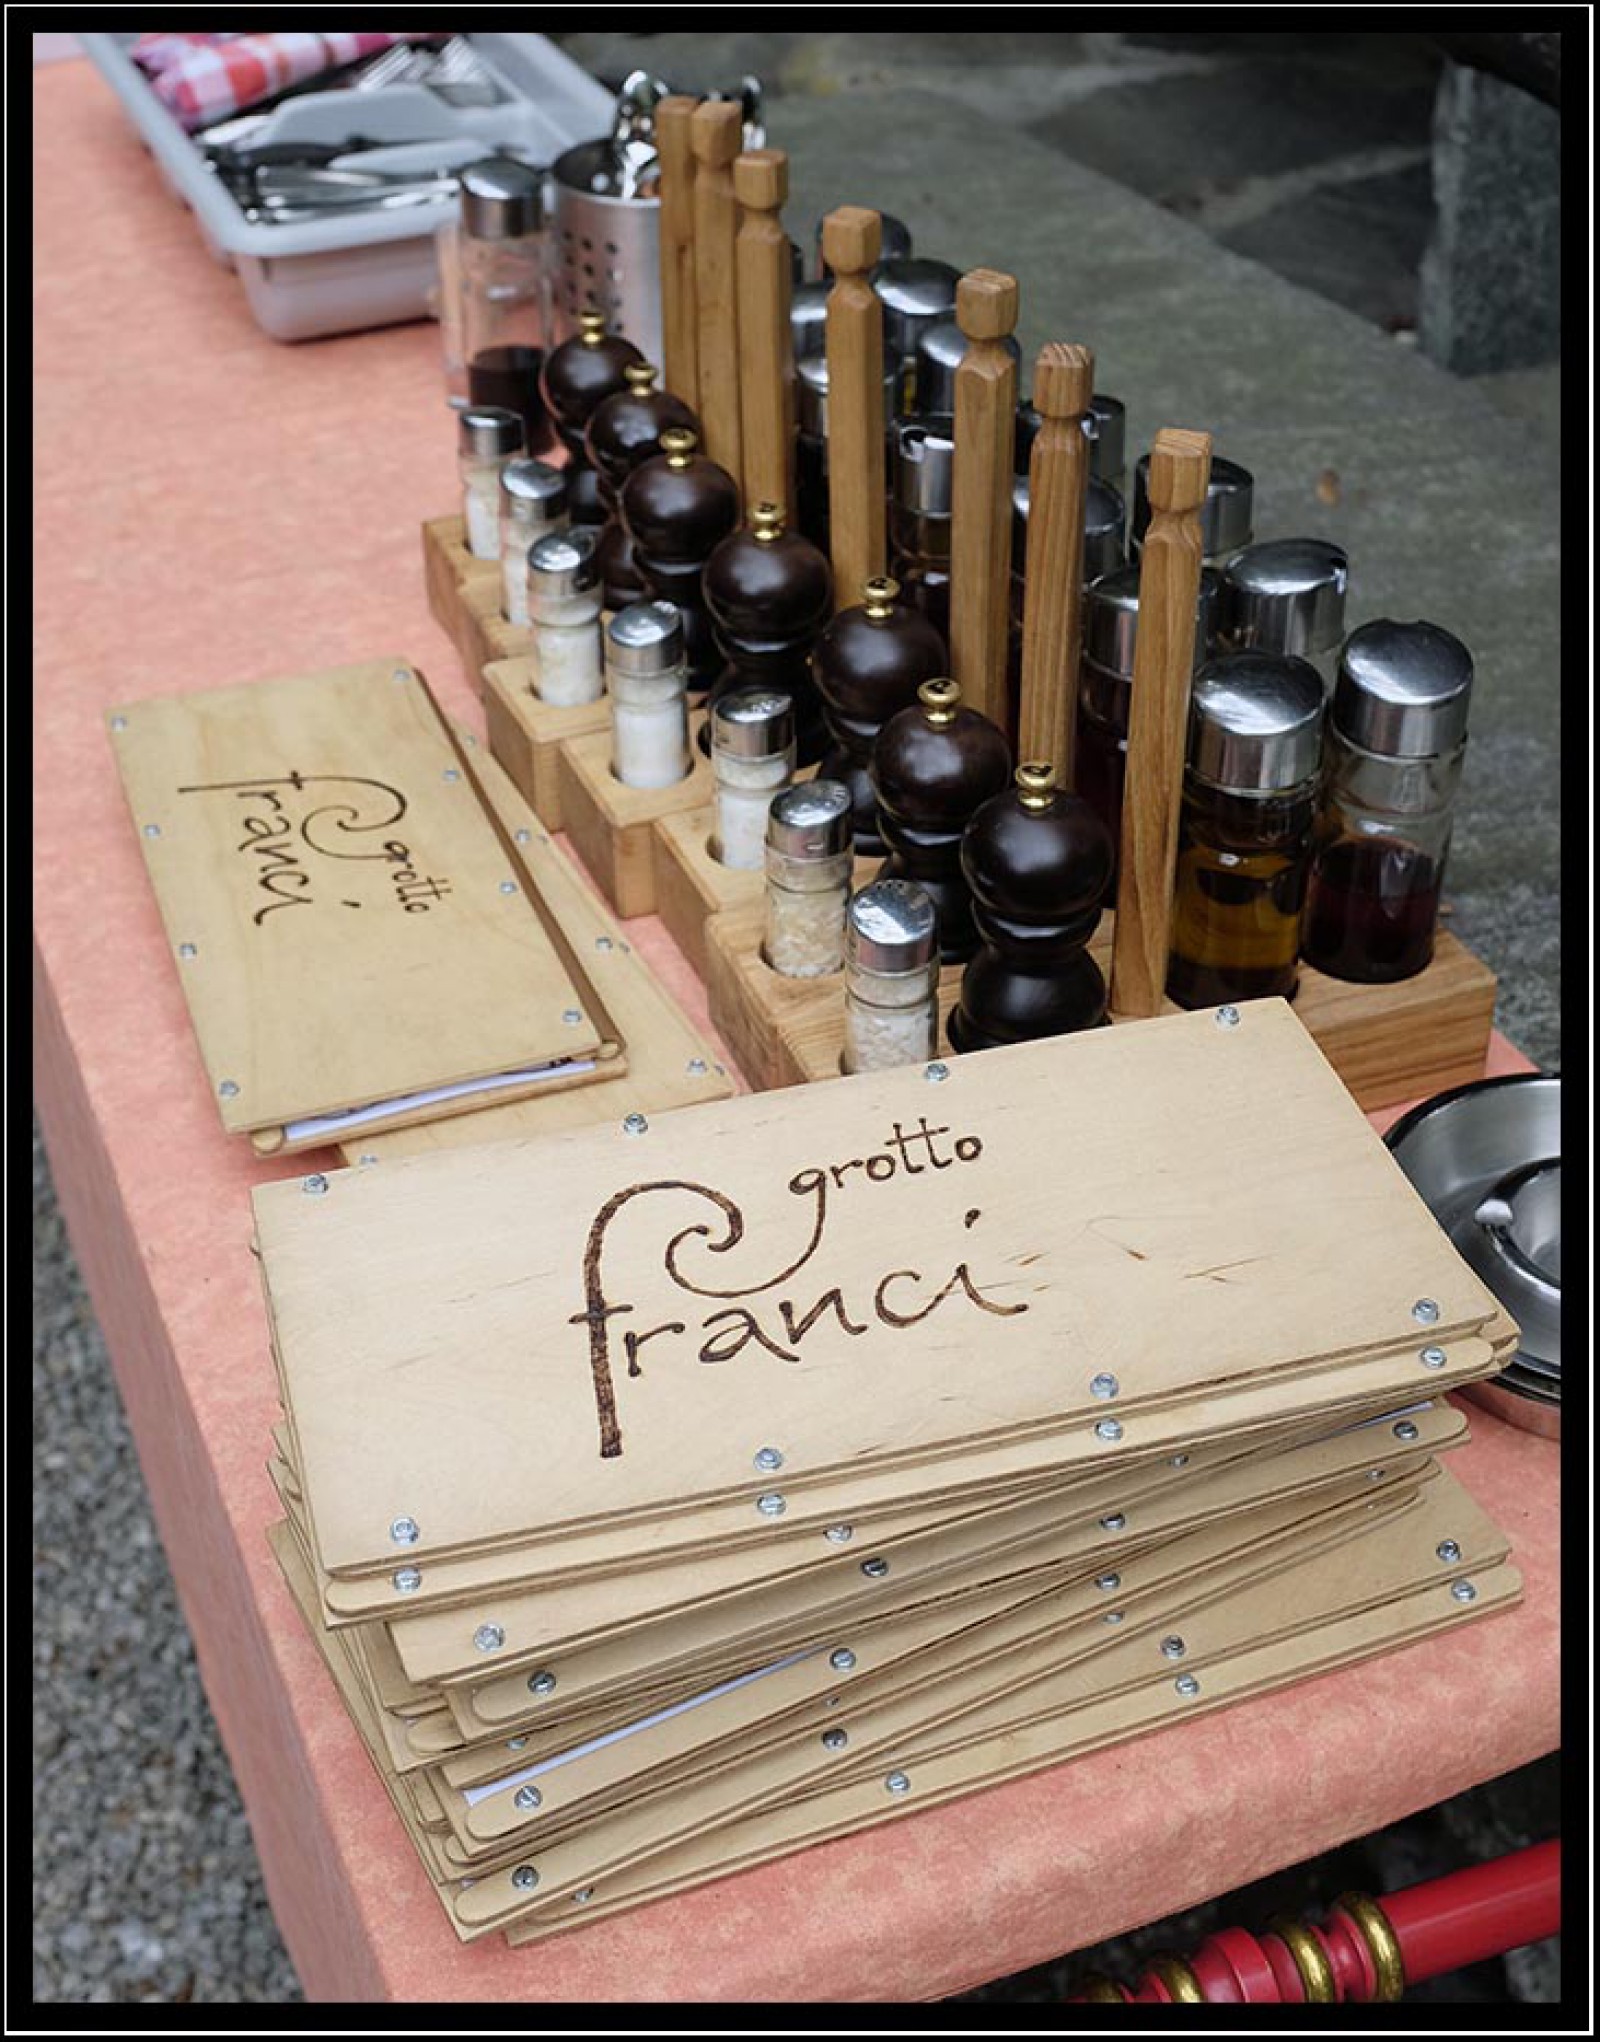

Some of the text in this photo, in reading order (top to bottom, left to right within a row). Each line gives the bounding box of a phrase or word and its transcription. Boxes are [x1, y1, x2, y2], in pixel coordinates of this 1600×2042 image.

[177, 770, 408, 926] franci
[330, 840, 453, 914] grotto
[785, 1118, 984, 1272] grotto
[568, 1181, 1030, 1458] franci
